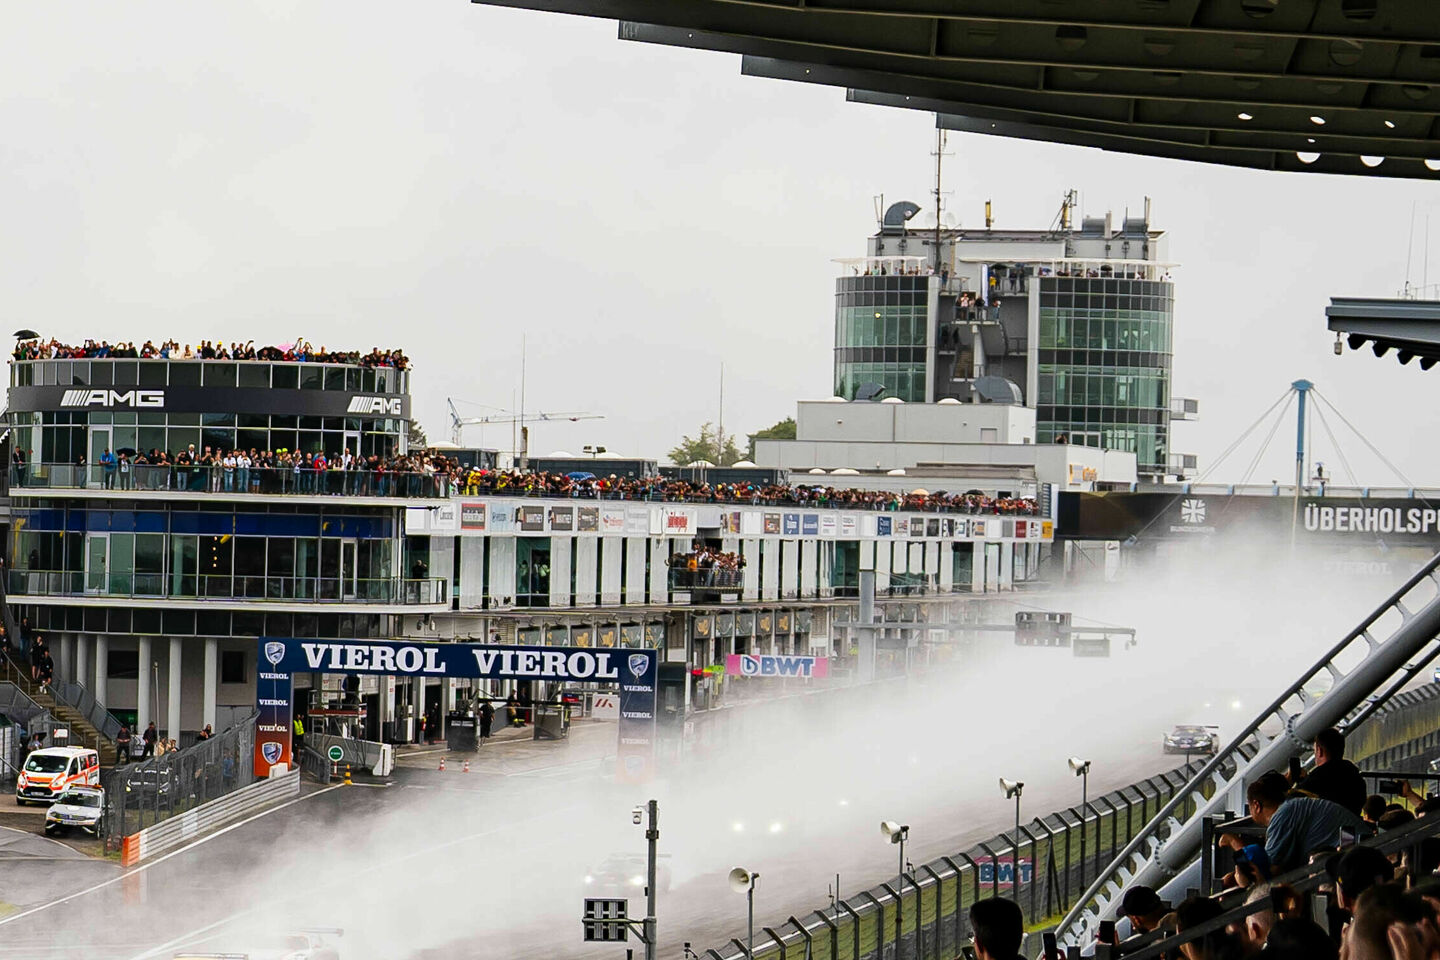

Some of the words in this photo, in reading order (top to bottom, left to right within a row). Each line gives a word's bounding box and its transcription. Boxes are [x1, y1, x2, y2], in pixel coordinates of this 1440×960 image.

[84, 390, 165, 408] AMG
[369, 396, 402, 415] AMG
[1304, 503, 1440, 534] ÜBERHOLSP
[301, 643, 446, 673] VIEROL
[472, 649, 619, 678] VIEROL
[761, 656, 814, 676] BWT
[260, 672, 289, 680] VIEROL
[980, 863, 1033, 882] BWT
